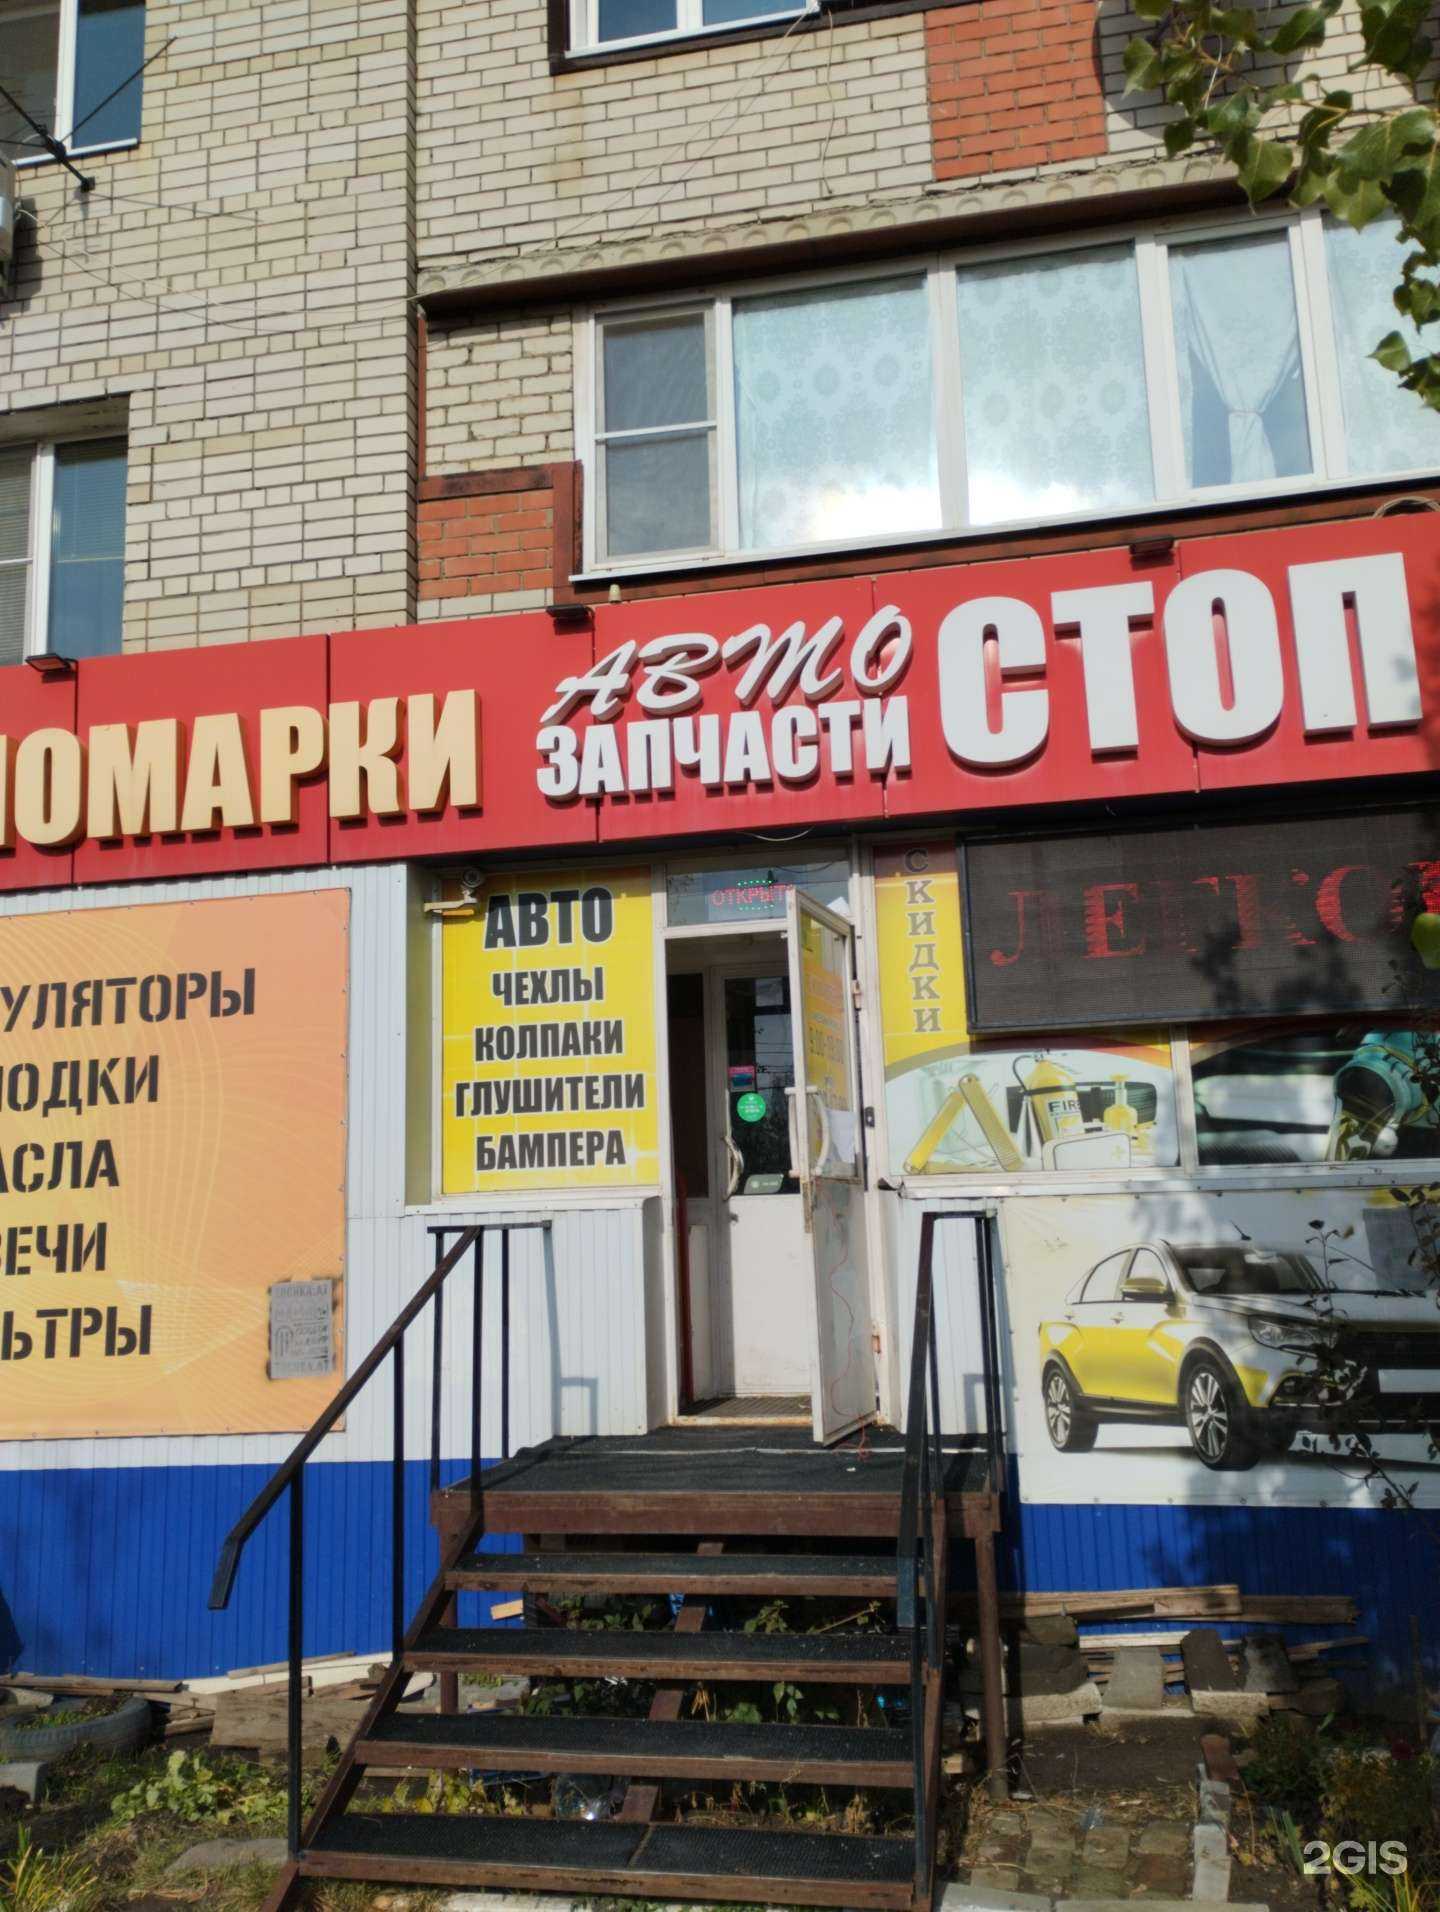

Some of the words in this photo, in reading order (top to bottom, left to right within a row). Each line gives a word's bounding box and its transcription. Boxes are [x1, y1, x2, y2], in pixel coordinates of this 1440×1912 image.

[540, 604, 912, 729] АВТО
[938, 552, 1422, 767] СТОП
[0, 689, 482, 848] ОМАРКИ
[535, 695, 911, 800] ЗАПЧАСТИ
[484, 887, 613, 949] АВТО
[903, 847, 942, 1034] СКИДКИ
[0, 967, 256, 1032] УЛЯТОРЫ
[493, 967, 605, 1006] ЧЕХЛЫ
[475, 1020, 624, 1062] КОЛПАКИ
[0, 1055, 159, 1117] ОДКИ
[456, 1073, 645, 1117] ГЛУШИТЕЛИ
[477, 1130, 627, 1171] БАМПЕРА
[0, 1222, 107, 1275] ЕЧИ
[2, 1304, 152, 1360] ЬТРЫ
